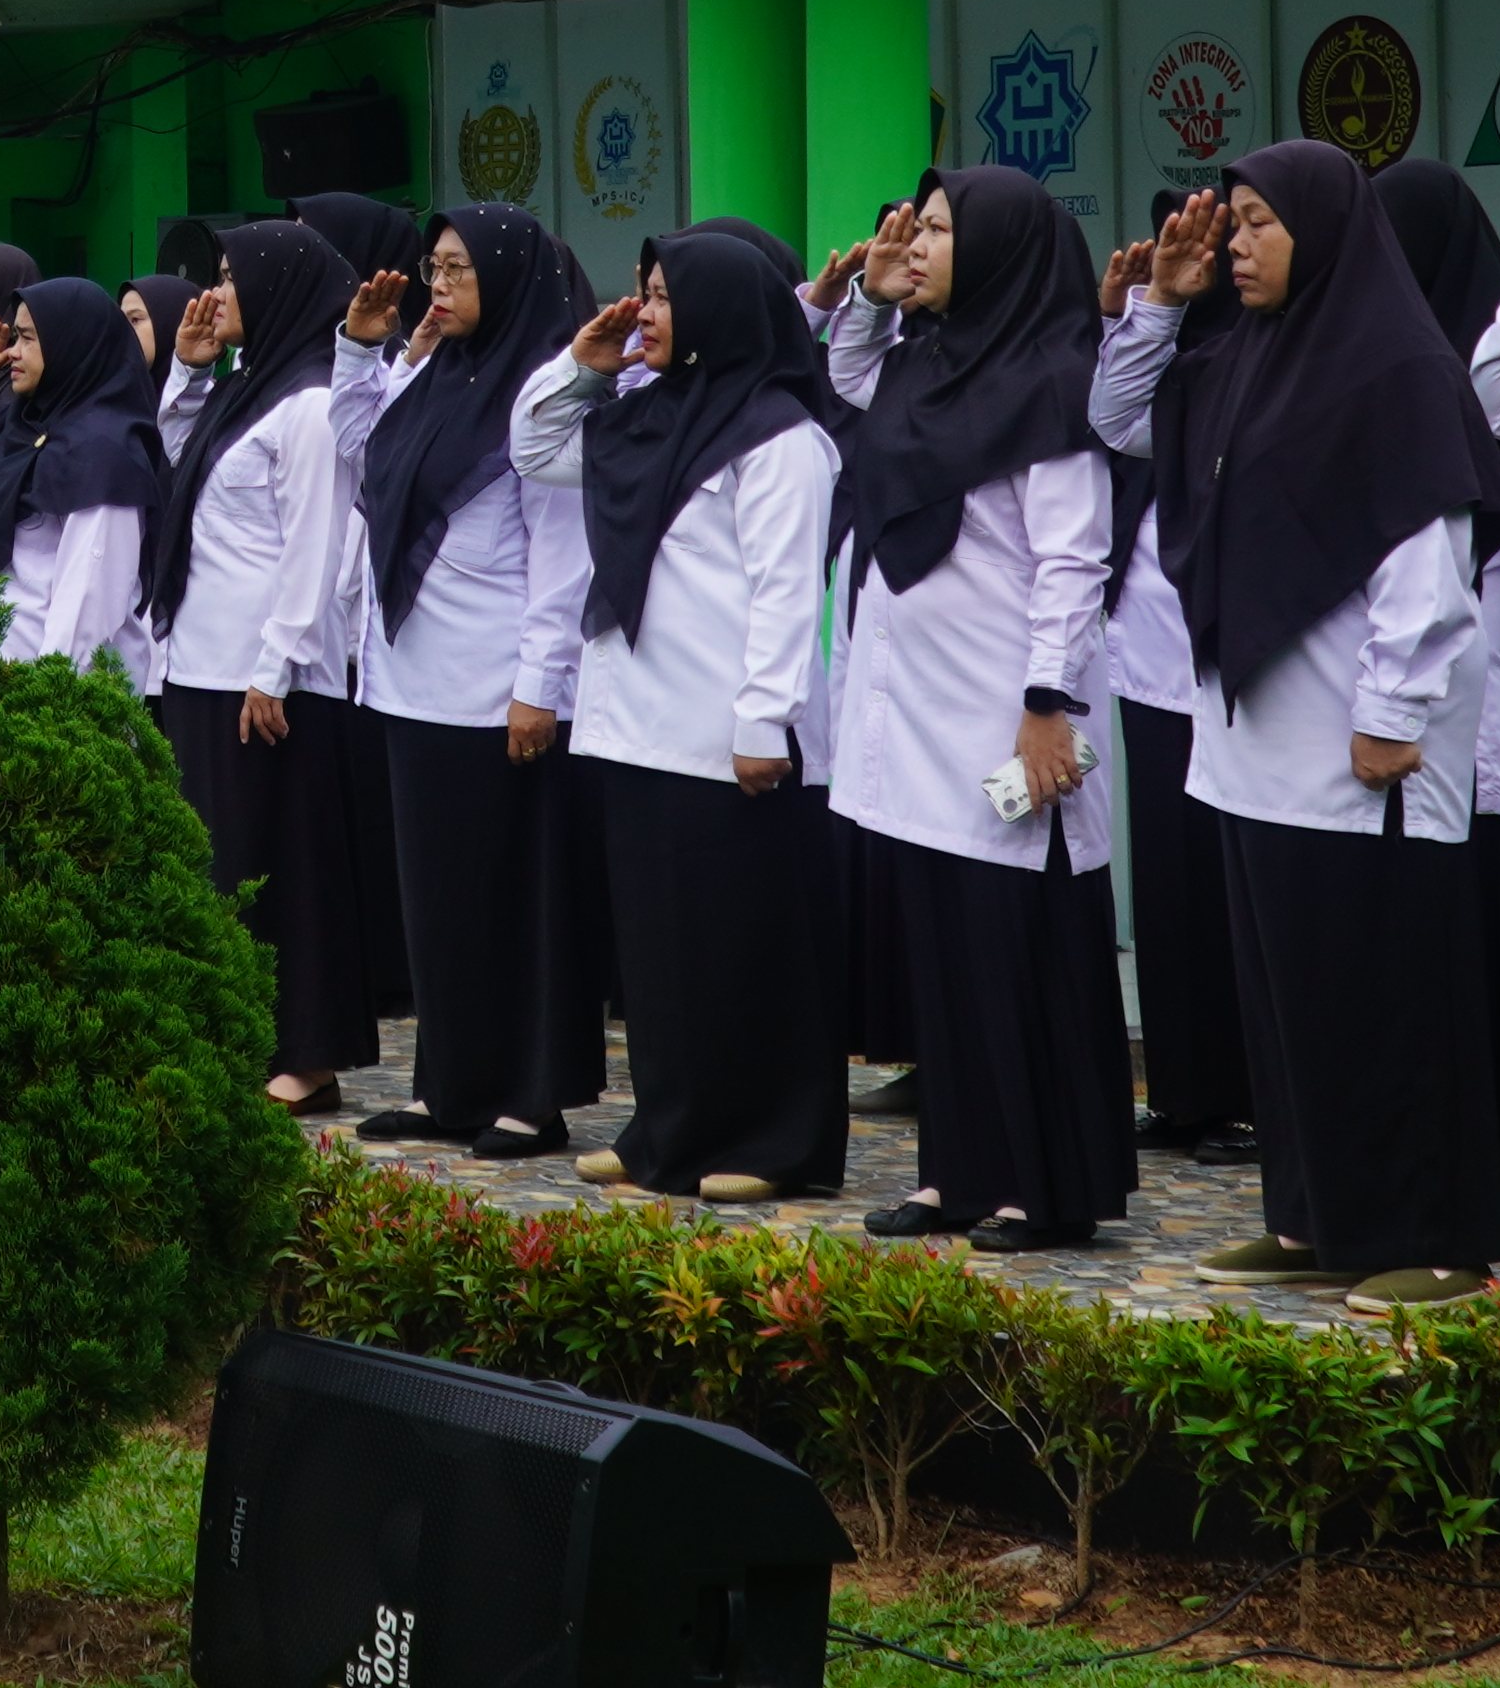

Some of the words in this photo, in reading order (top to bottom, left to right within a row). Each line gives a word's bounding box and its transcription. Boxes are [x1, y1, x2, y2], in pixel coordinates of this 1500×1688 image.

[1147, 53, 1179, 101] ZONA
[1178, 41, 1246, 93] INTEGRITAS
[1189, 118, 1214, 144] NO
[356, 1644, 372, 1688] JS
